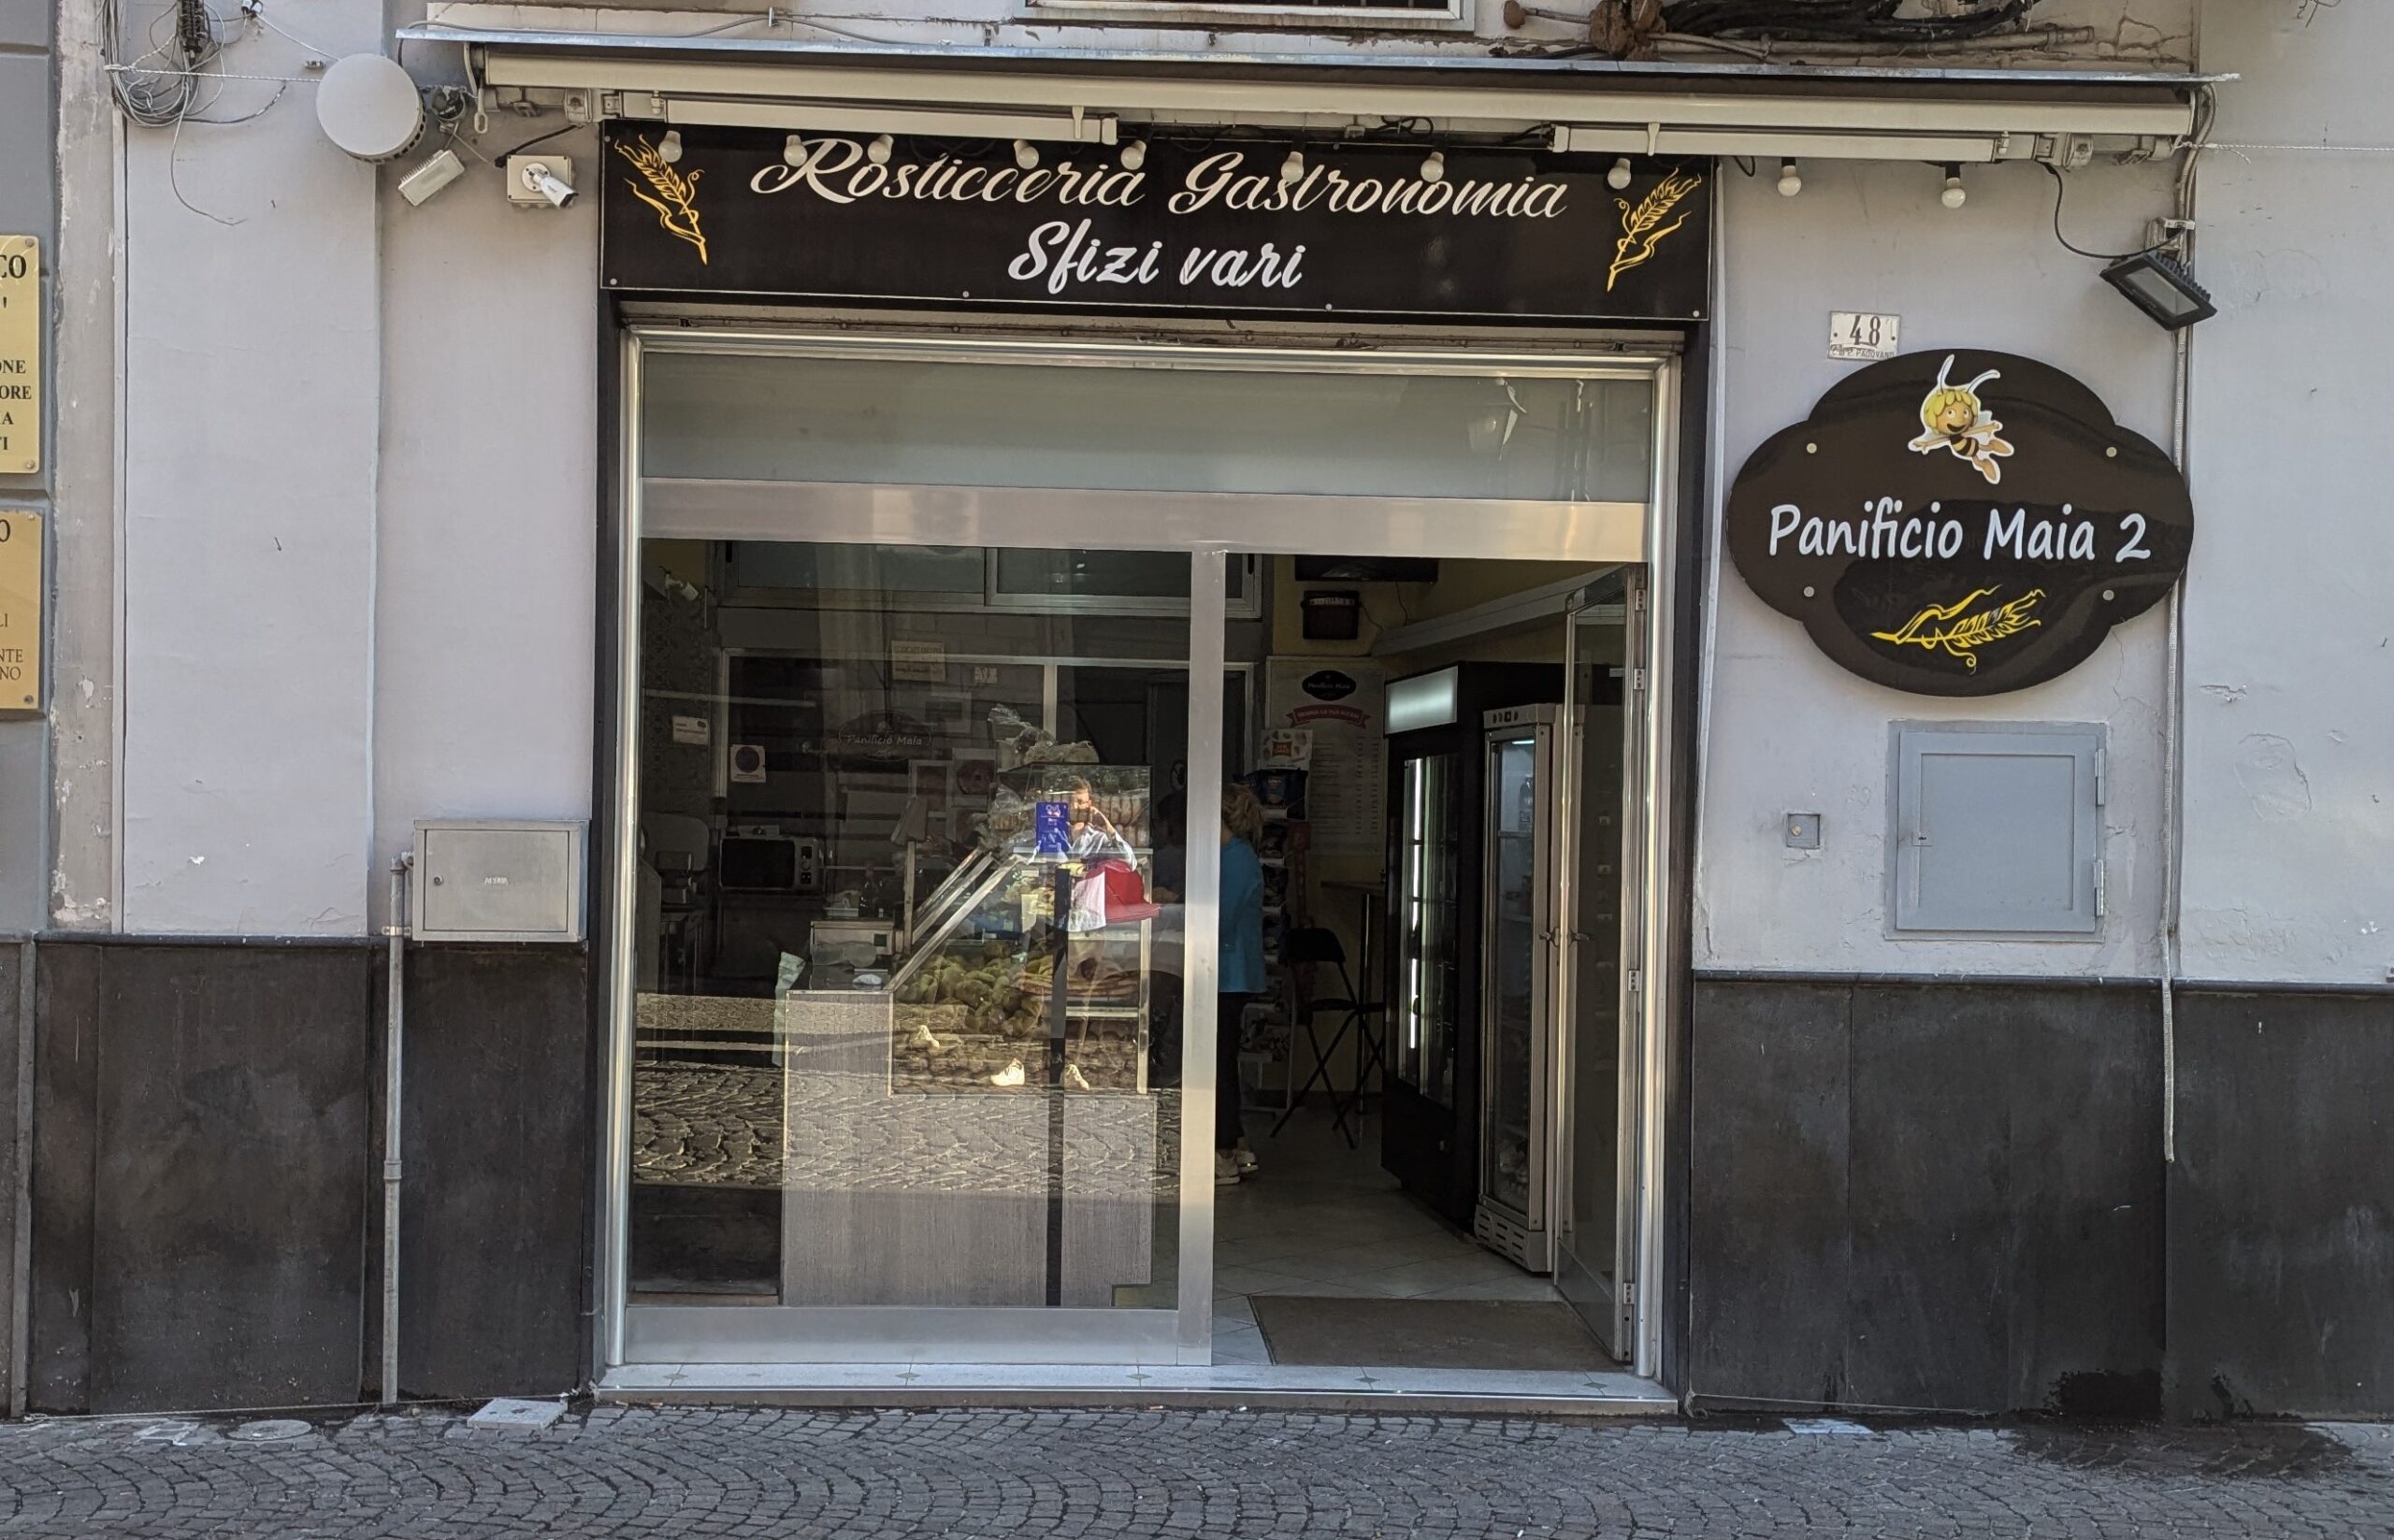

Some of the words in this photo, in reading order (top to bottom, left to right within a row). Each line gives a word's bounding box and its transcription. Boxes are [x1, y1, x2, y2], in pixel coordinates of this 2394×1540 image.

[749, 137, 1147, 206] Rosticceria
[1167, 151, 1568, 219] Gastronomia
[1007, 218, 1162, 295] Sfizi
[1178, 240, 1306, 289] vari
[1849, 314, 1882, 347] 48
[0, 360, 26, 374] NE
[1767, 496, 1964, 559] Panificio
[1983, 503, 2096, 561] Maia
[2114, 512, 2152, 563] 2
